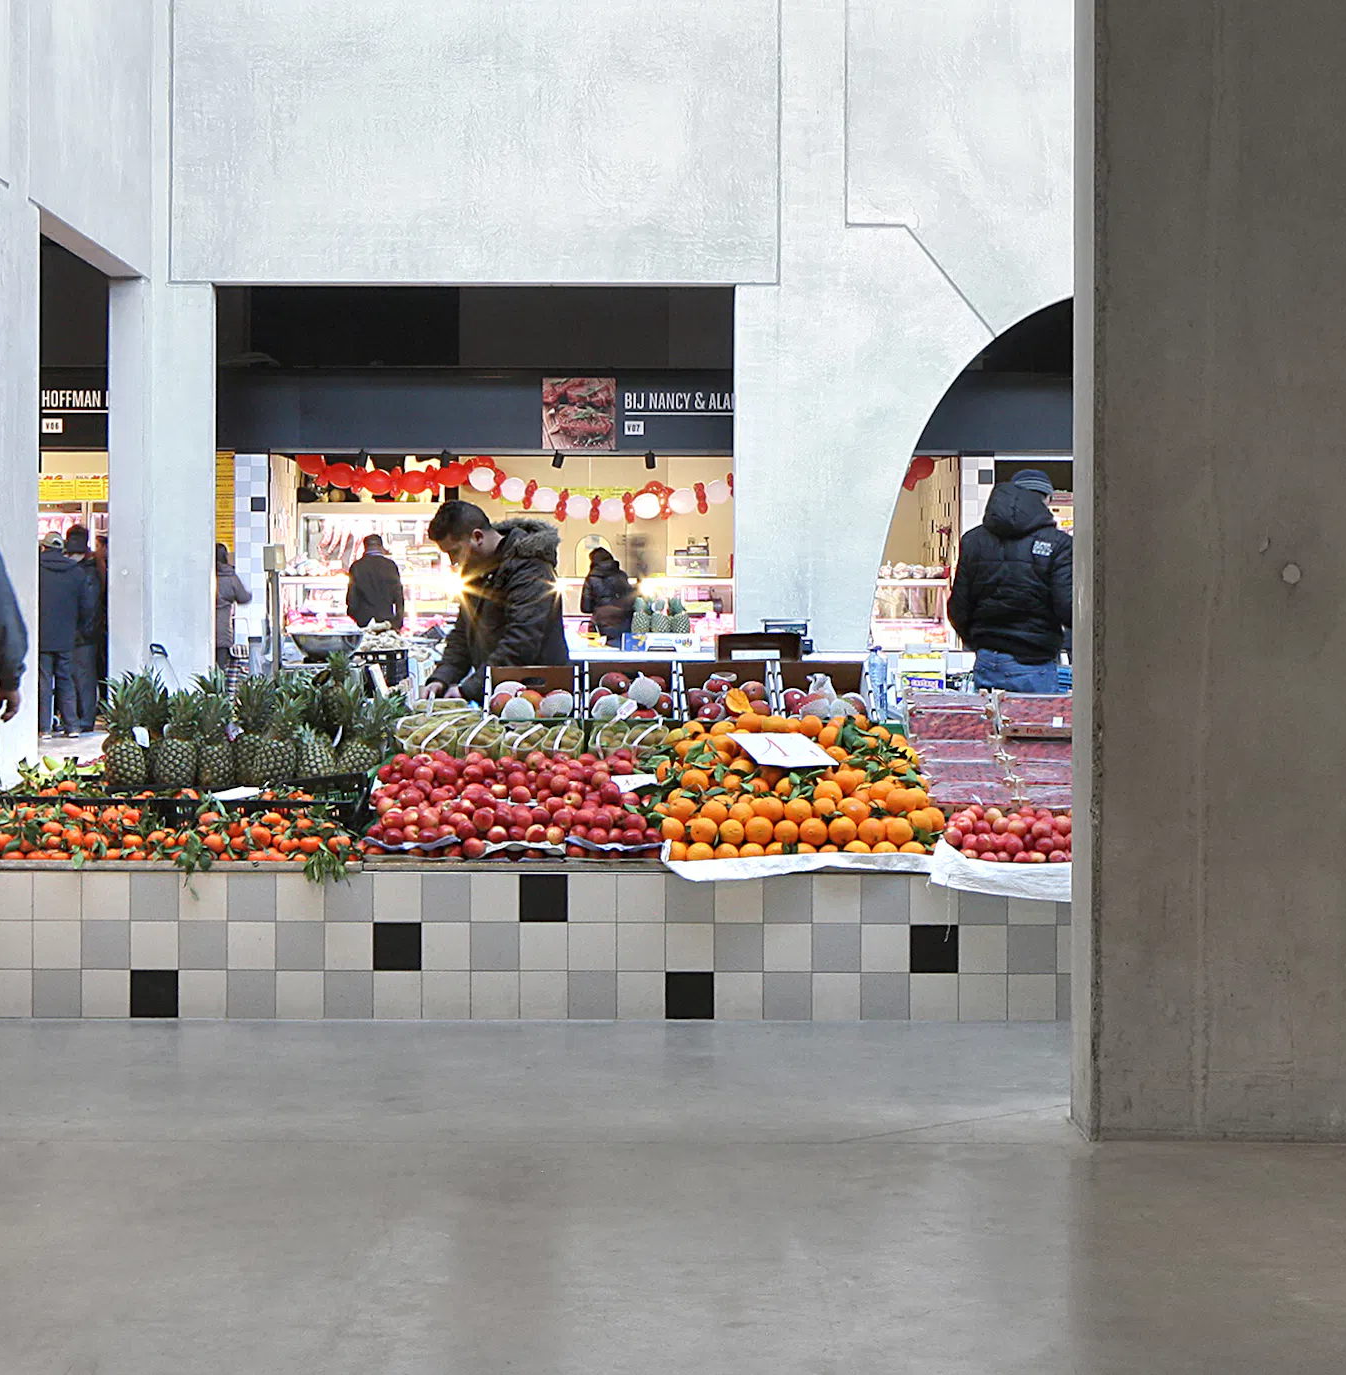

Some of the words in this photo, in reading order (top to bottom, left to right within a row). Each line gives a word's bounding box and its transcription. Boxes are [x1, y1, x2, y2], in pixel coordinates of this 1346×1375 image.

[41, 390, 101, 408] HOFFMAN
[624, 392, 645, 410] BIJ
[649, 392, 691, 410] NANCY
[694, 391, 706, 410] &
